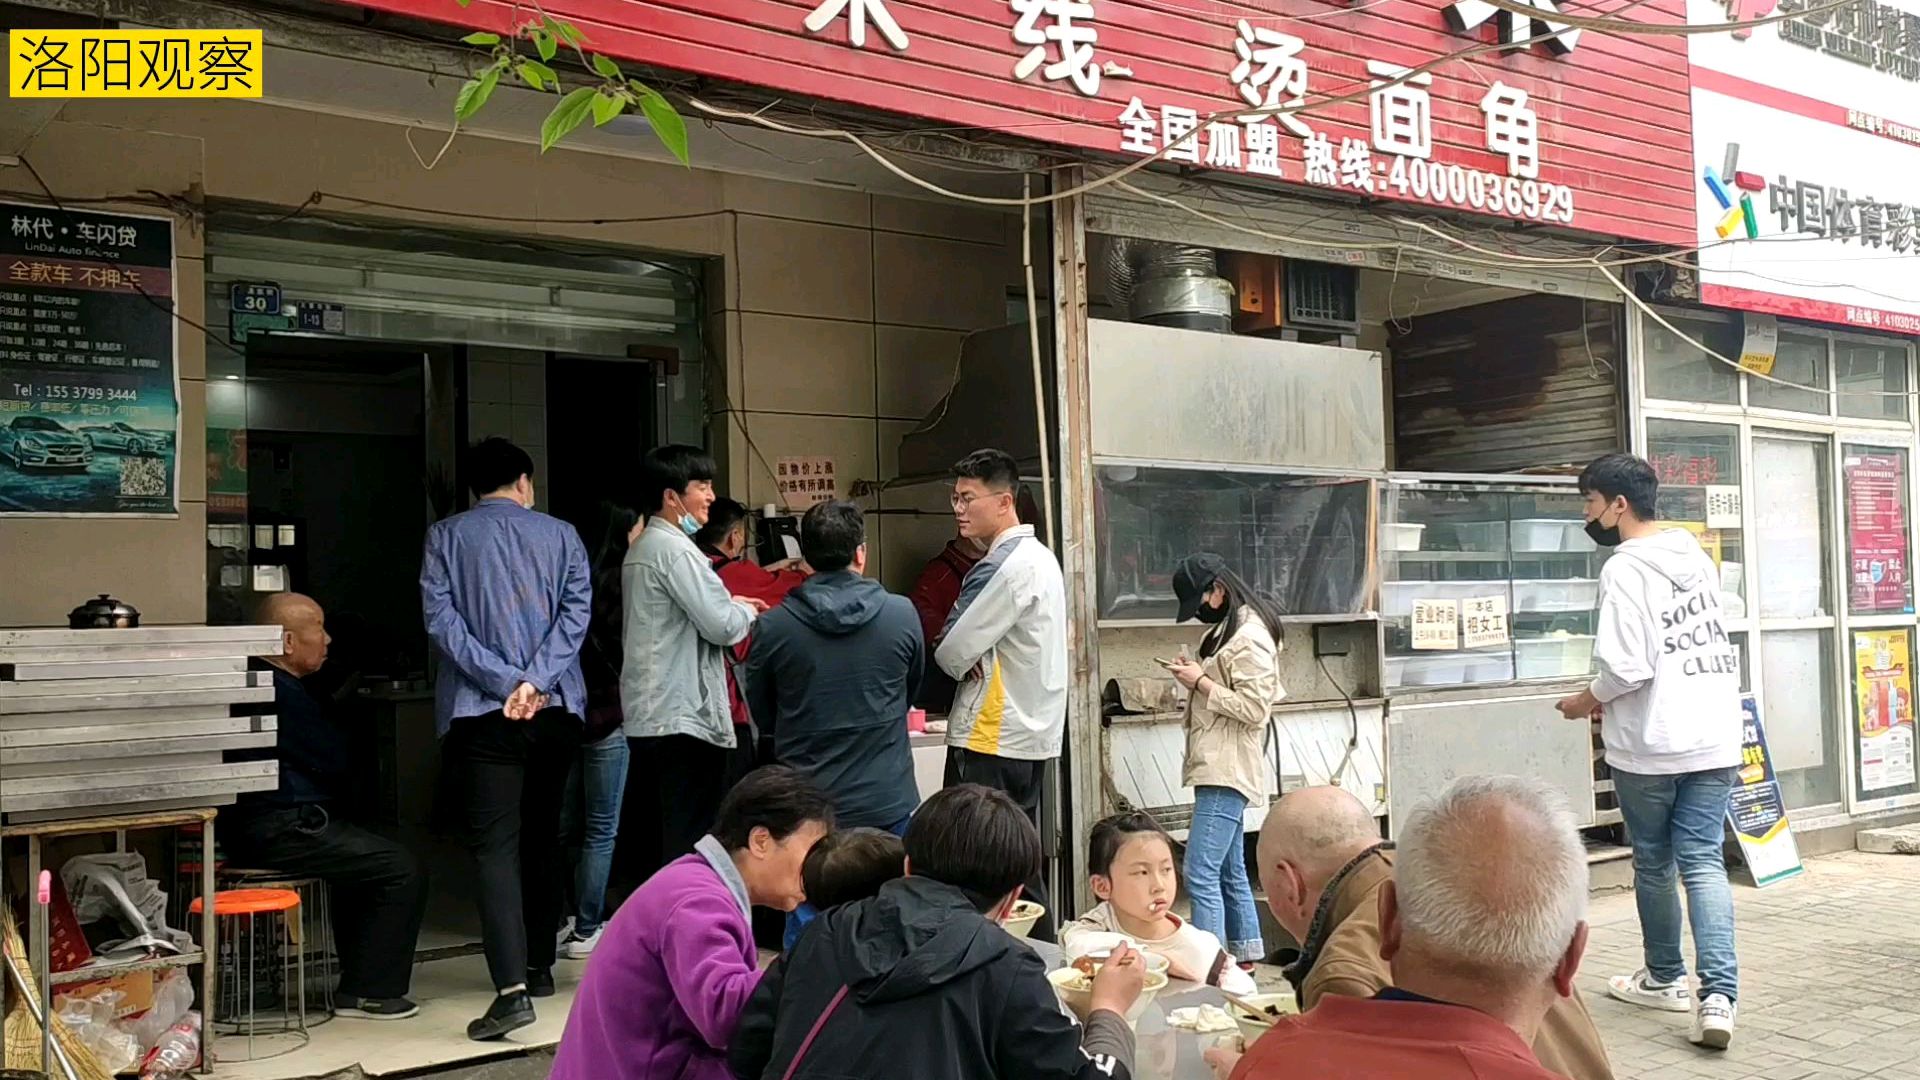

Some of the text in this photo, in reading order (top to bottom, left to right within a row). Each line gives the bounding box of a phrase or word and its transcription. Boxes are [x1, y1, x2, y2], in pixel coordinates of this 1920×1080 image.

[1230, 19, 1539, 179] 烫面角
[1117, 96, 1574, 223] 全国加盟 热线:4000036929
[25, 242, 56, 253] LinDai
[58, 245, 82, 256] Auto
[9, 260, 142, 290] 全款车 不押车
[245, 296, 266, 310] 30
[46, 385, 68, 398] 155
[72, 386, 103, 400] 3799
[107, 390, 137, 401] 3444
[778, 461, 834, 476] 因物价上涨
[1467, 615, 1503, 634] 招女工
